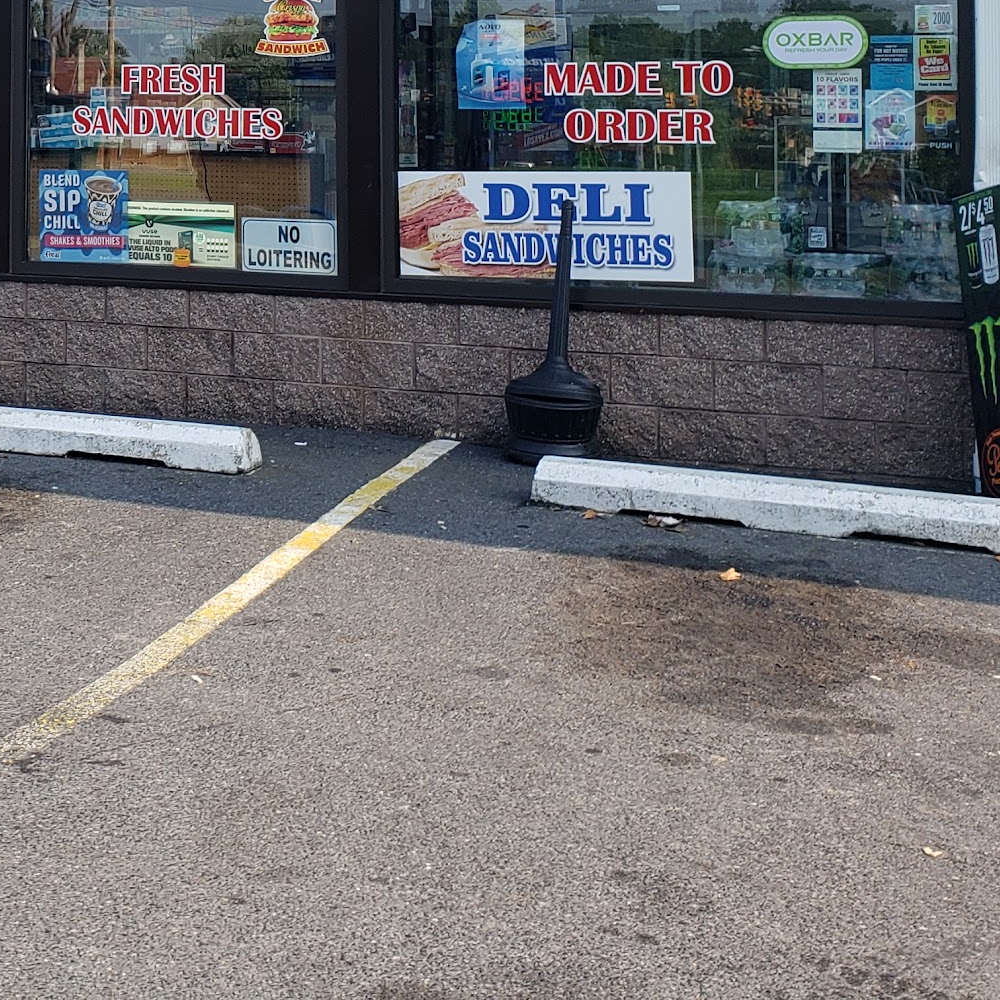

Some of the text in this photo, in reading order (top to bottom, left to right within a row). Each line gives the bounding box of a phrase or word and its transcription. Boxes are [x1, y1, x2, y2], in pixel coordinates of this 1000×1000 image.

[932, 12, 951, 25] 2000
[257, 41, 326, 54] SANDWICH
[775, 32, 854, 47] OXBAR
[920, 63, 949, 73] Card
[924, 57, 945, 65] We
[121, 64, 226, 96] FRESH
[544, 60, 734, 97] MADE TO
[71, 106, 284, 141] SANDWICHES
[563, 108, 715, 145] ORDER
[43, 173, 81, 187] BLEND
[44, 189, 81, 212] SIP
[482, 182, 653, 225] DELI
[44, 214, 81, 230] CHILL
[50, 236, 120, 246] SHAKES & SMOOTHIES
[278, 225, 300, 243] NO
[128, 252, 161, 261] EQUALS
[163, 252, 173, 261] 10
[248, 247, 331, 270] LOITERING
